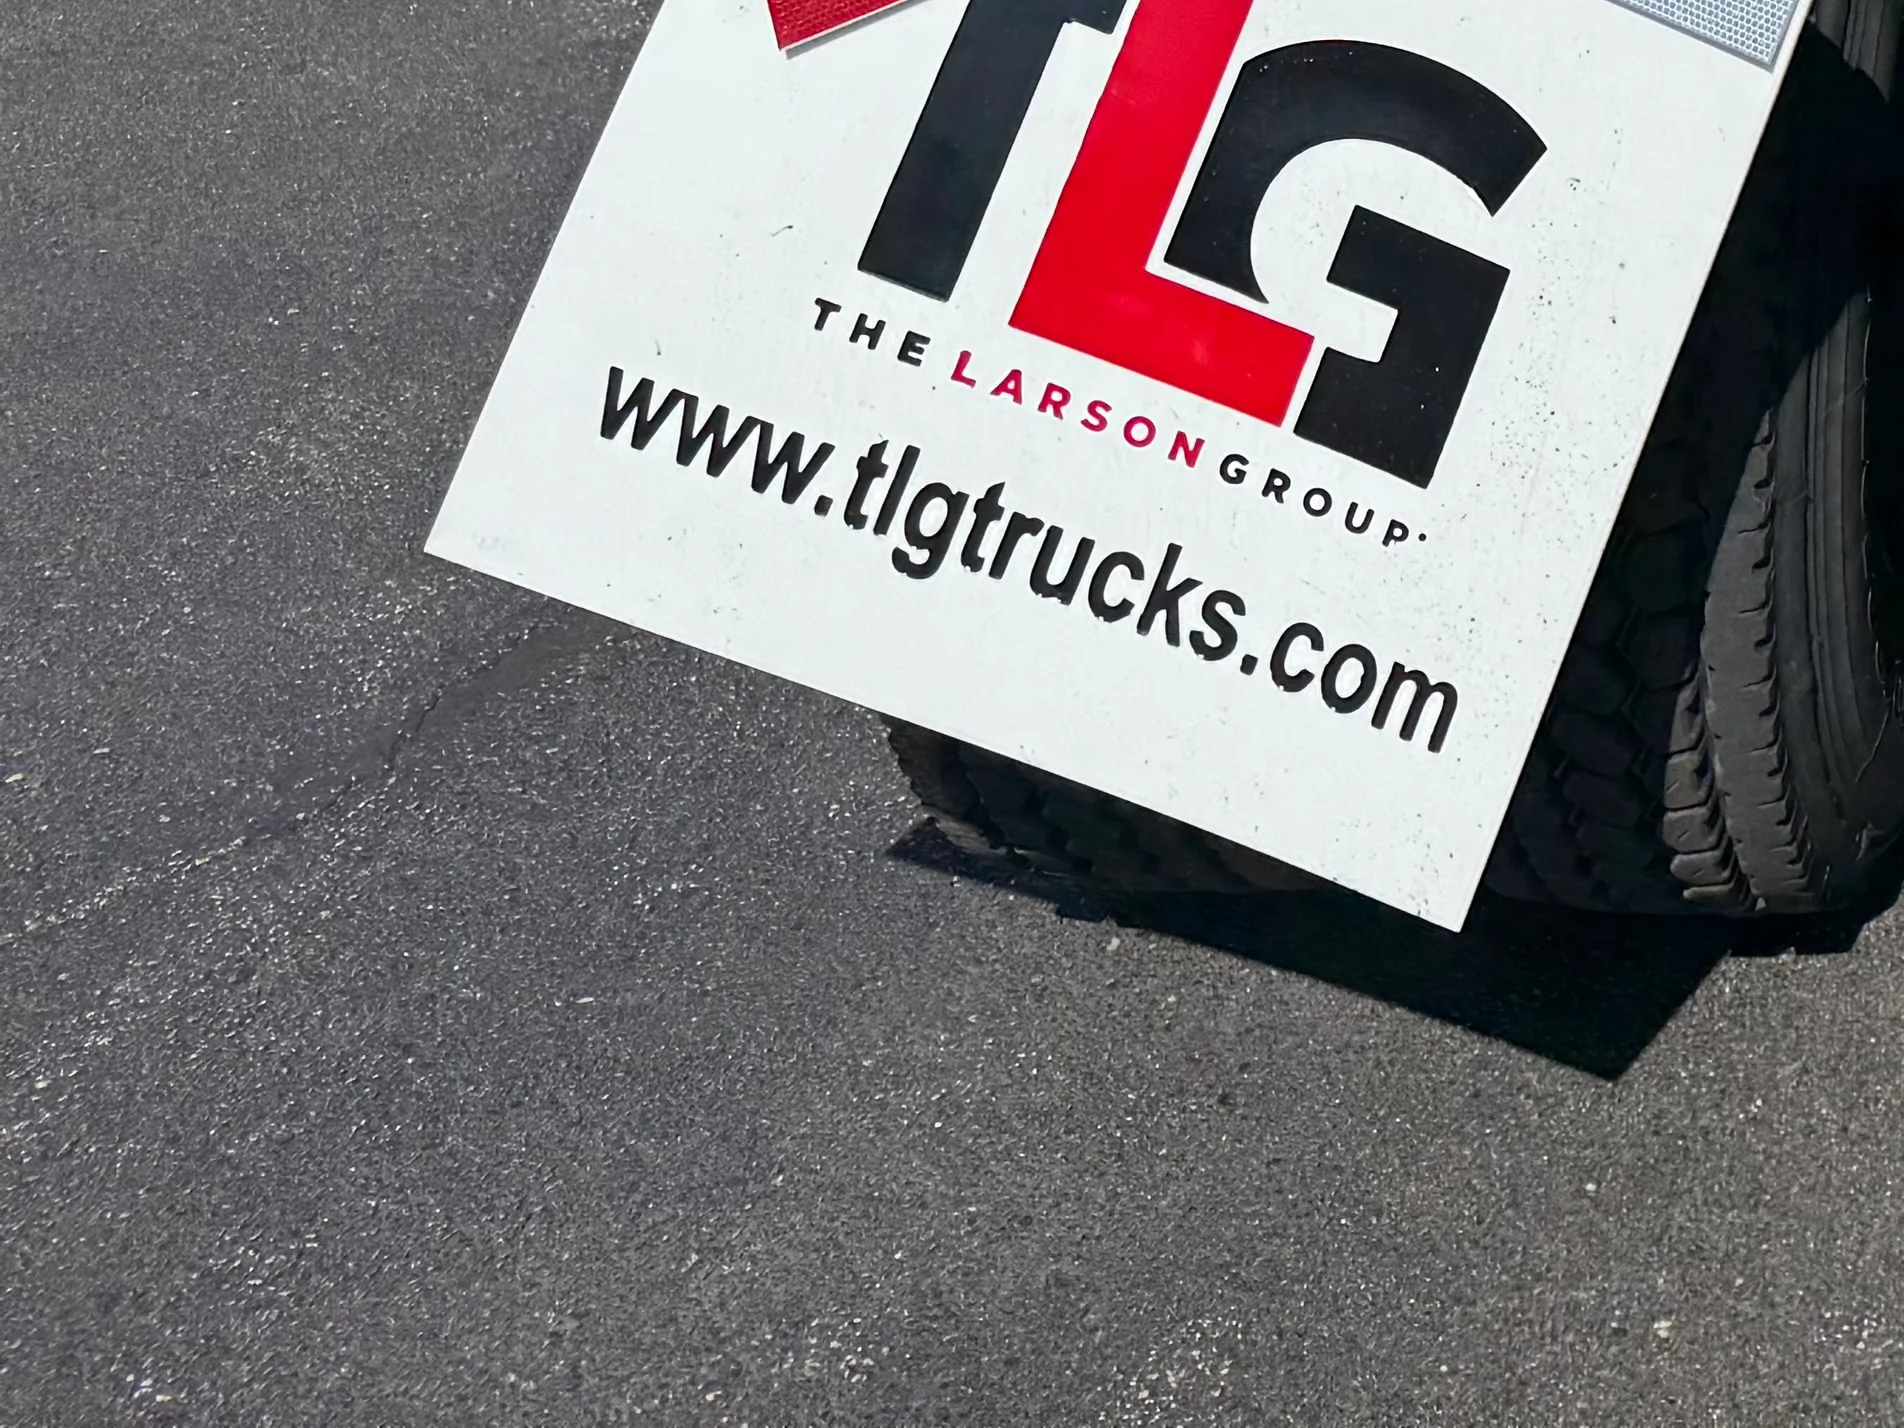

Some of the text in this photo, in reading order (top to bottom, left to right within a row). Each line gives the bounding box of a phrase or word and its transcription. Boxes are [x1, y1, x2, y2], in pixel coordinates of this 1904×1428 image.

[600, 366, 1458, 754] www.tlgtrucks.com
[813, 297, 1411, 547] THE LARSON GROUP
